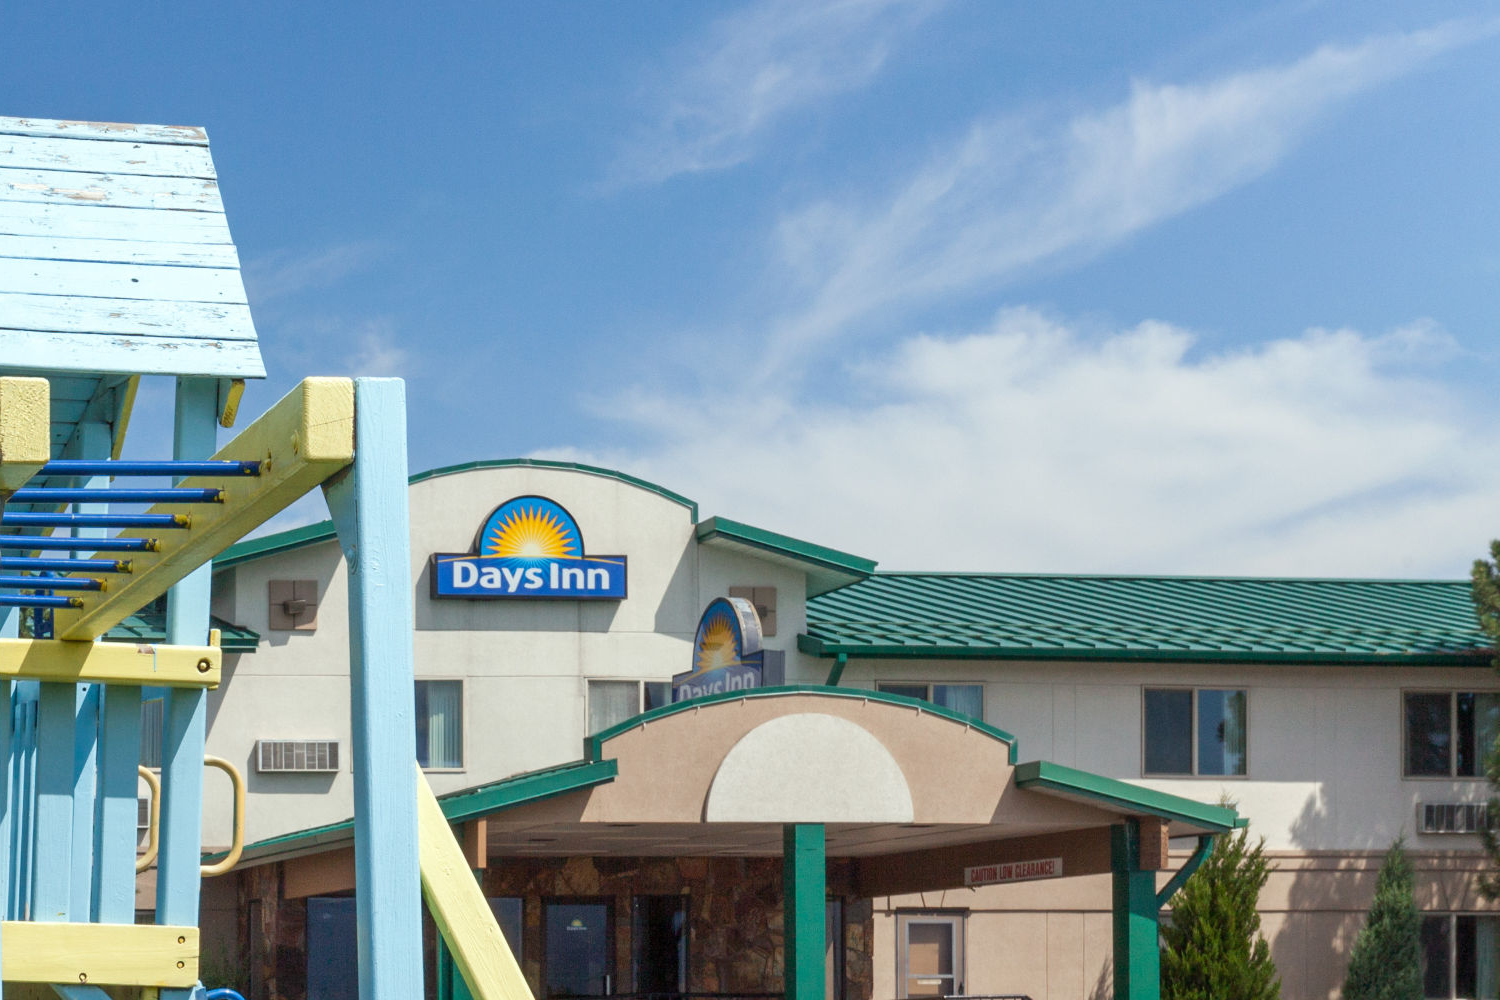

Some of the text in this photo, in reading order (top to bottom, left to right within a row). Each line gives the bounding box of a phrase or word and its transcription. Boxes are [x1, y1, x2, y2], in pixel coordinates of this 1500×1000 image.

[453, 561, 610, 593] Days Inn
[970, 860, 1055, 883] CAUTION LOW CLEARANCE!
